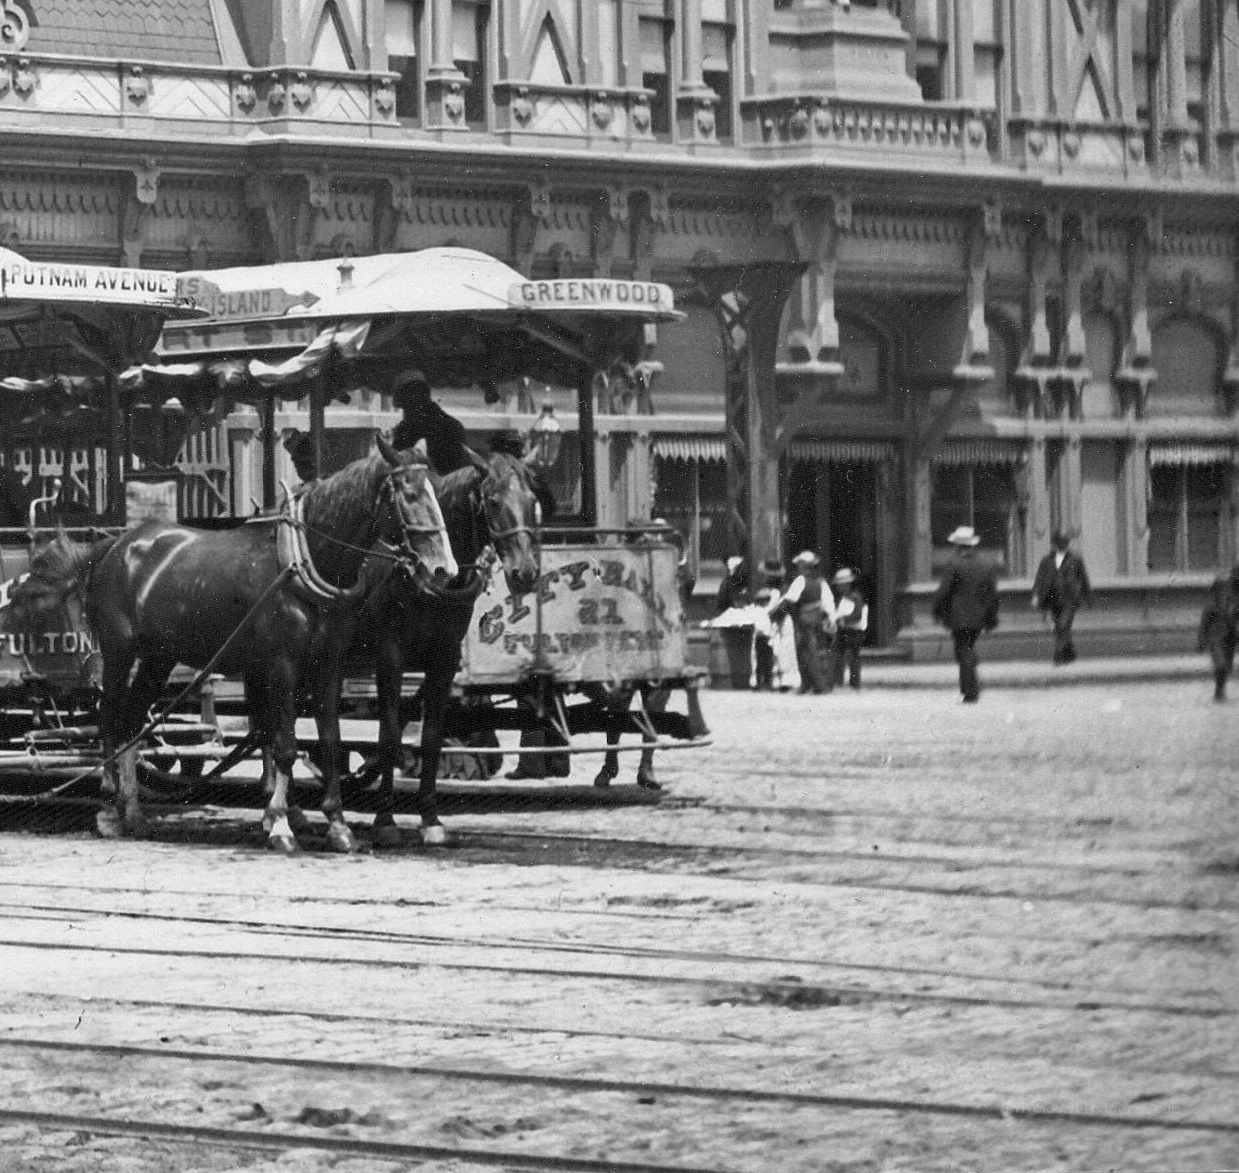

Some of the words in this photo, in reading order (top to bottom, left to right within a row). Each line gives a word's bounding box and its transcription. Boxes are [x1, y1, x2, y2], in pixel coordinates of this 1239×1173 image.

[11, 264, 87, 288] PUTNAM
[95, 271, 168, 293] AVENUE
[520, 282, 660, 304] GREENWOOD
[479, 560, 590, 645] CITY
